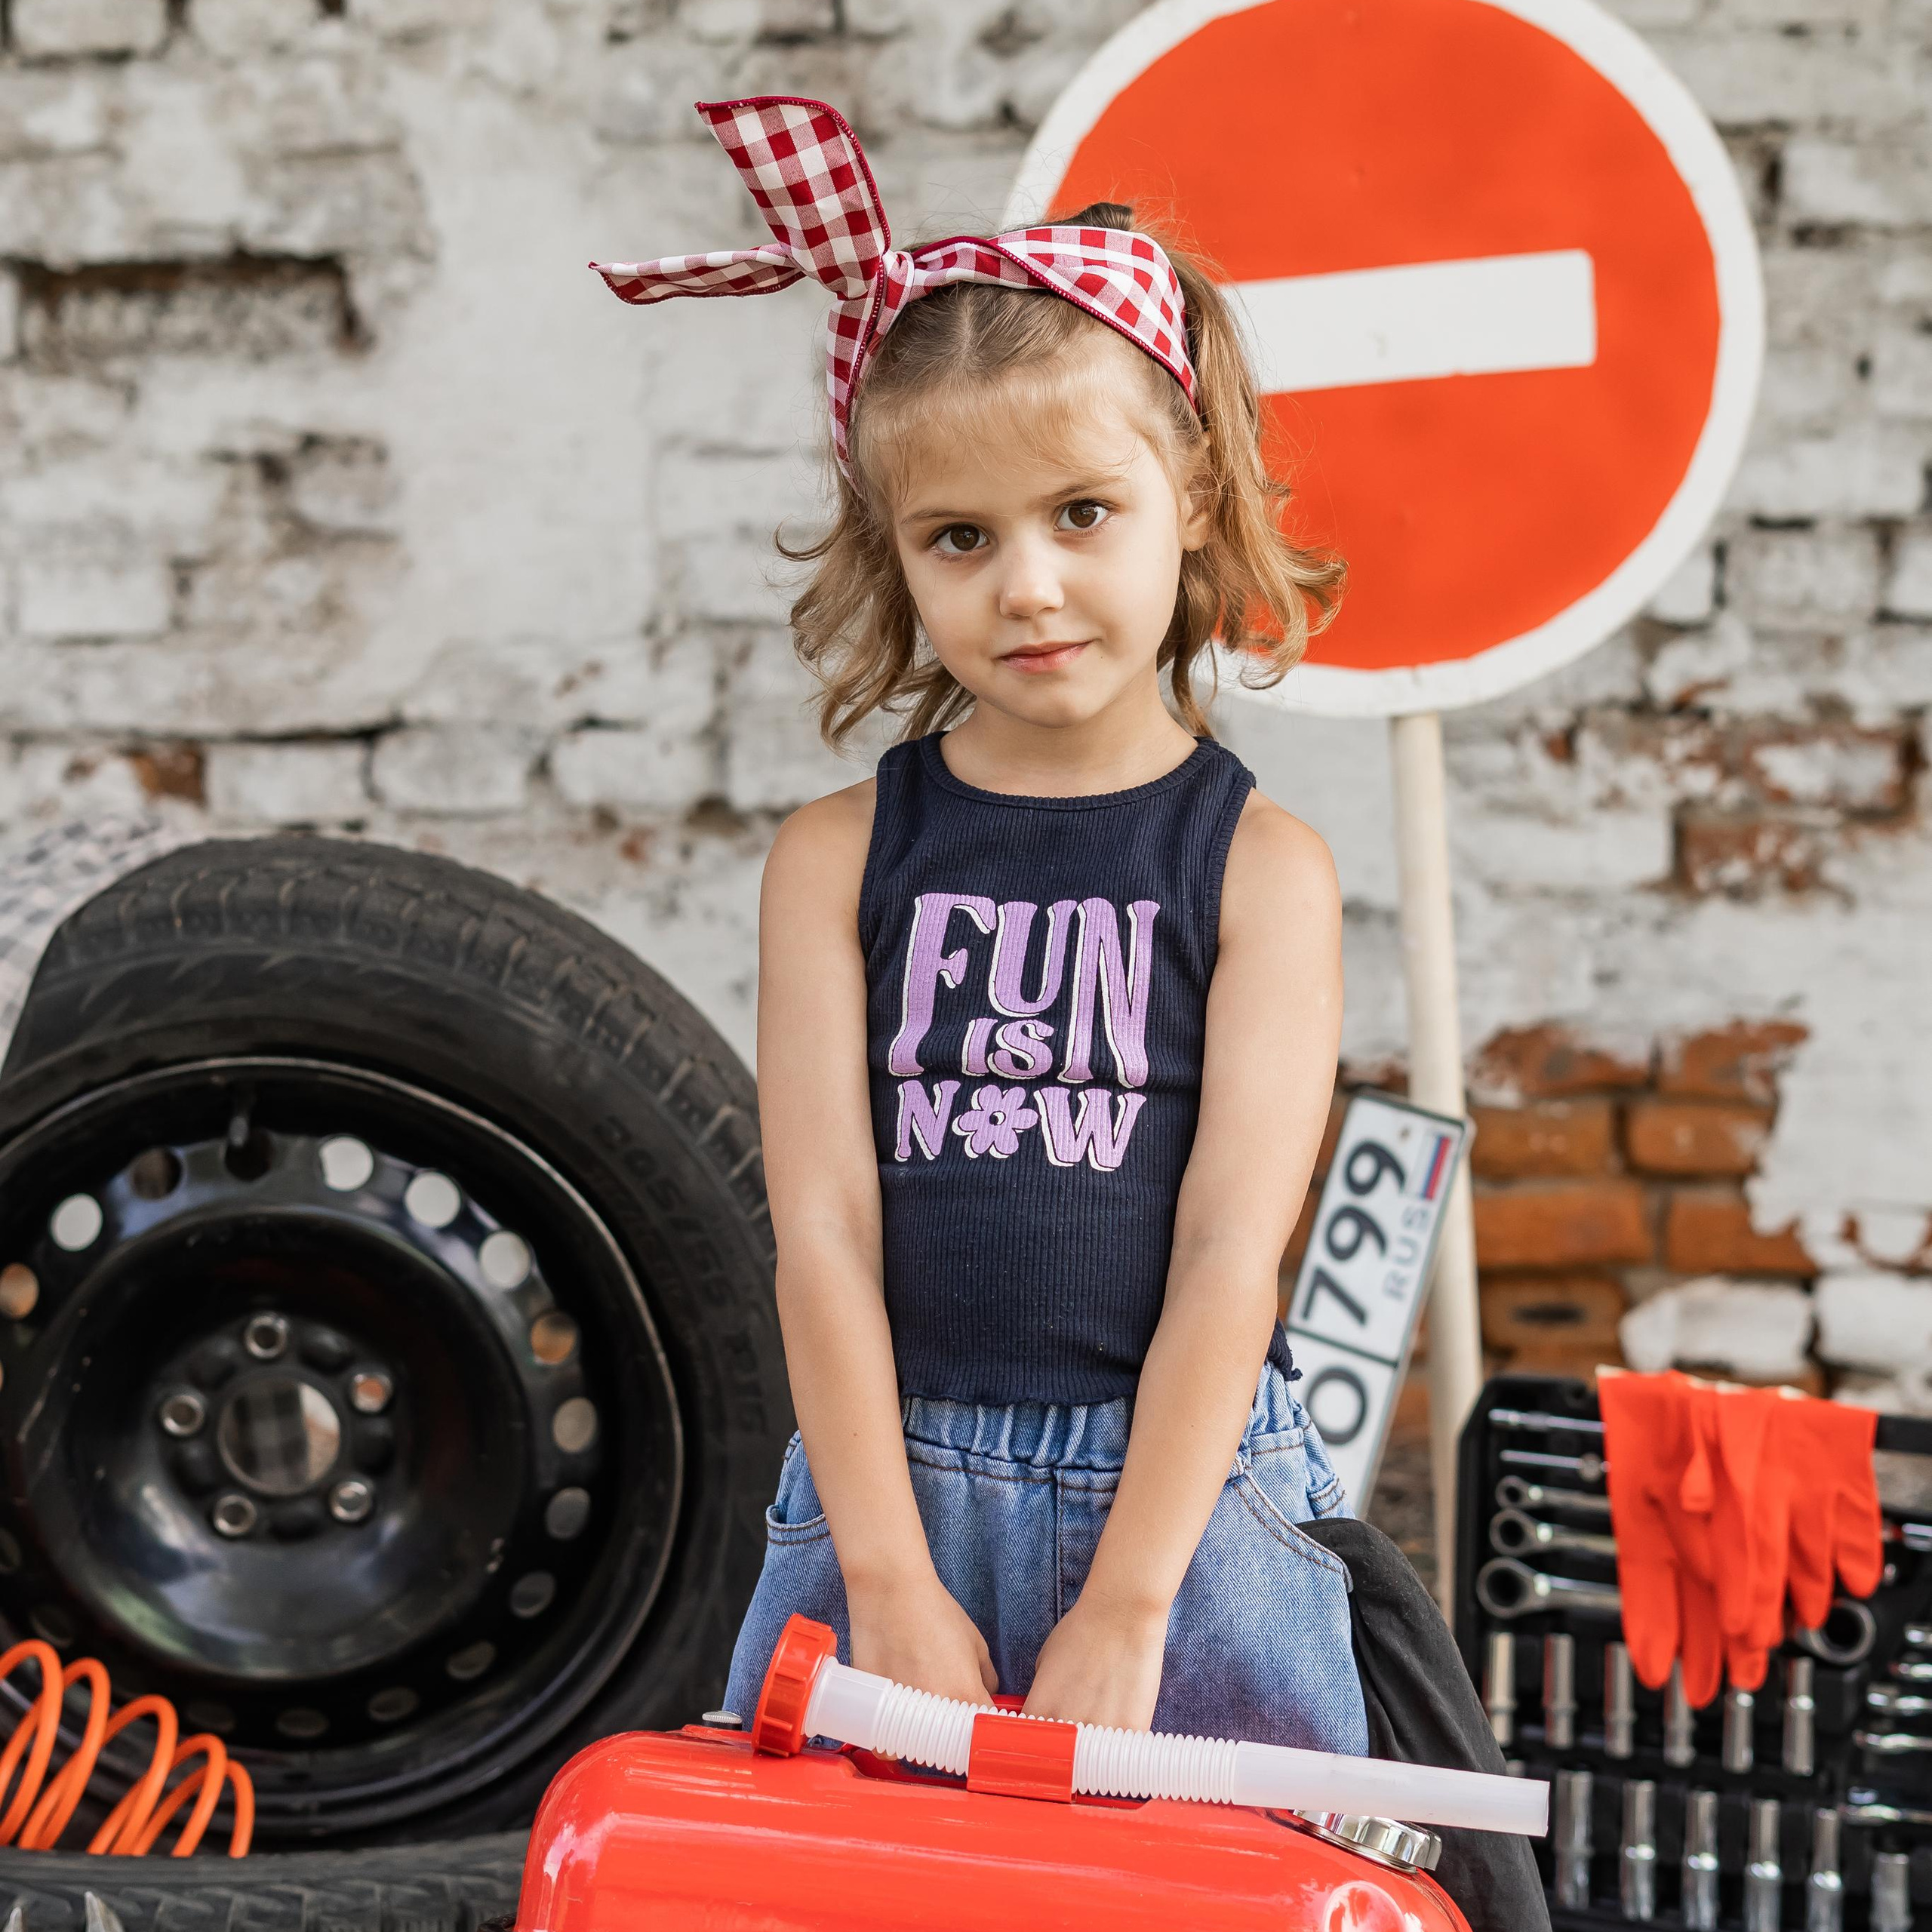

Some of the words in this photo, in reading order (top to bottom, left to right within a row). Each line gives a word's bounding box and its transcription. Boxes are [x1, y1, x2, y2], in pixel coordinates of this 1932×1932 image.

[889, 893, 1161, 1088] FUN
[961, 1017, 1054, 1079] IS
[1303, 1140, 1406, 1326] 799
[1382, 1203, 1431, 1302] RUS
